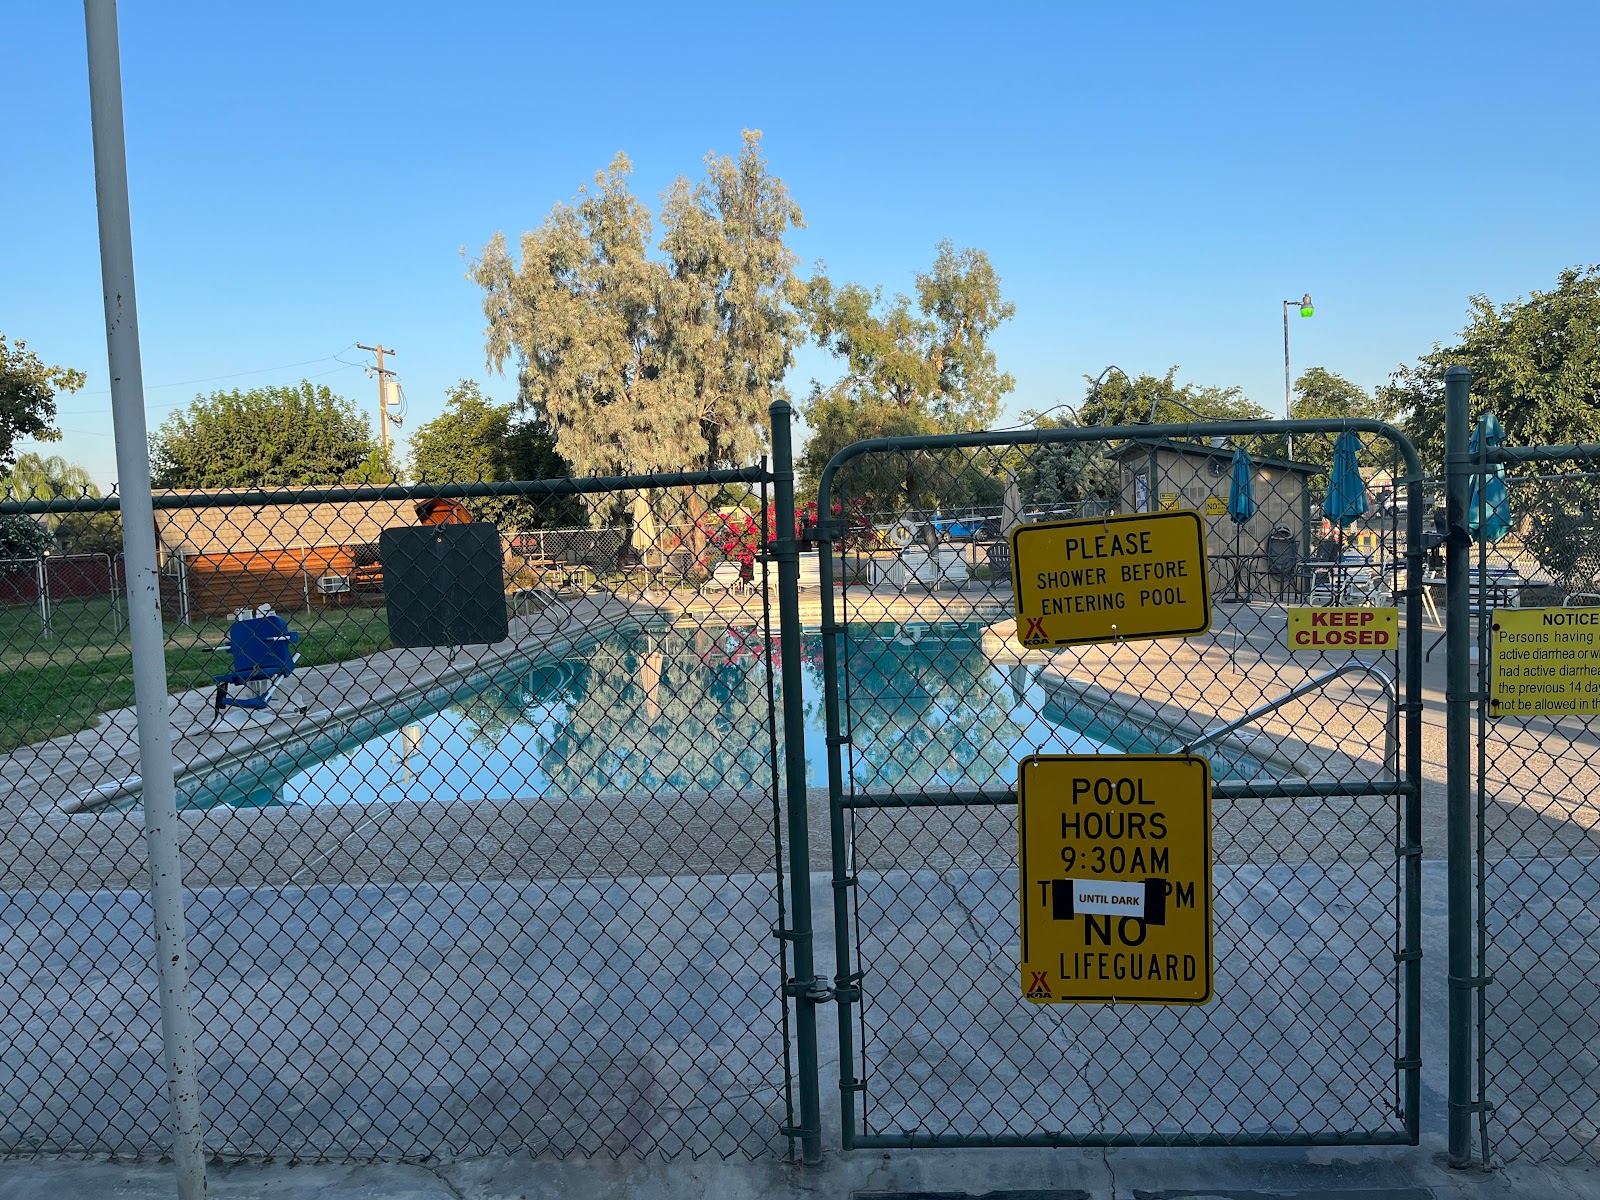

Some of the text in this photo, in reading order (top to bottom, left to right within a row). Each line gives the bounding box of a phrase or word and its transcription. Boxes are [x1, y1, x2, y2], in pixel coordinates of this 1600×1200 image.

[1065, 532, 1153, 560] PLEASE
[1037, 560, 1188, 589] SHOWER BEFORE
[1041, 587, 1187, 616] ENTERING POOL
[1311, 612, 1375, 627] KEEP
[1543, 613, 1599, 626] NOTICE
[1023, 638, 1050, 646] KOA
[1295, 630, 1389, 645] CLOSED
[1499, 631, 1549, 643] Persons
[1554, 630, 1594, 645] having
[1499, 648, 1530, 660] active
[1532, 648, 1575, 660] diarrhea
[1577, 650, 1588, 659] or
[1499, 665, 1520, 677] had
[1523, 665, 1556, 676] active
[1498, 682, 1516, 694] the
[1518, 682, 1565, 696] previous
[1569, 681, 1582, 693] 14
[1497, 699, 1515, 710] not
[1518, 699, 1531, 710] be
[1534, 699, 1576, 710] allowed
[1579, 698, 1589, 710] in
[1072, 777, 1156, 805] POOL
[1060, 811, 1168, 840] HOURS
[1060, 846, 1170, 874] 9:30AM
[1079, 893, 1140, 906] UNTIL DARK
[1084, 913, 1147, 946] NO
[1060, 952, 1196, 981] LIFEGUARD
